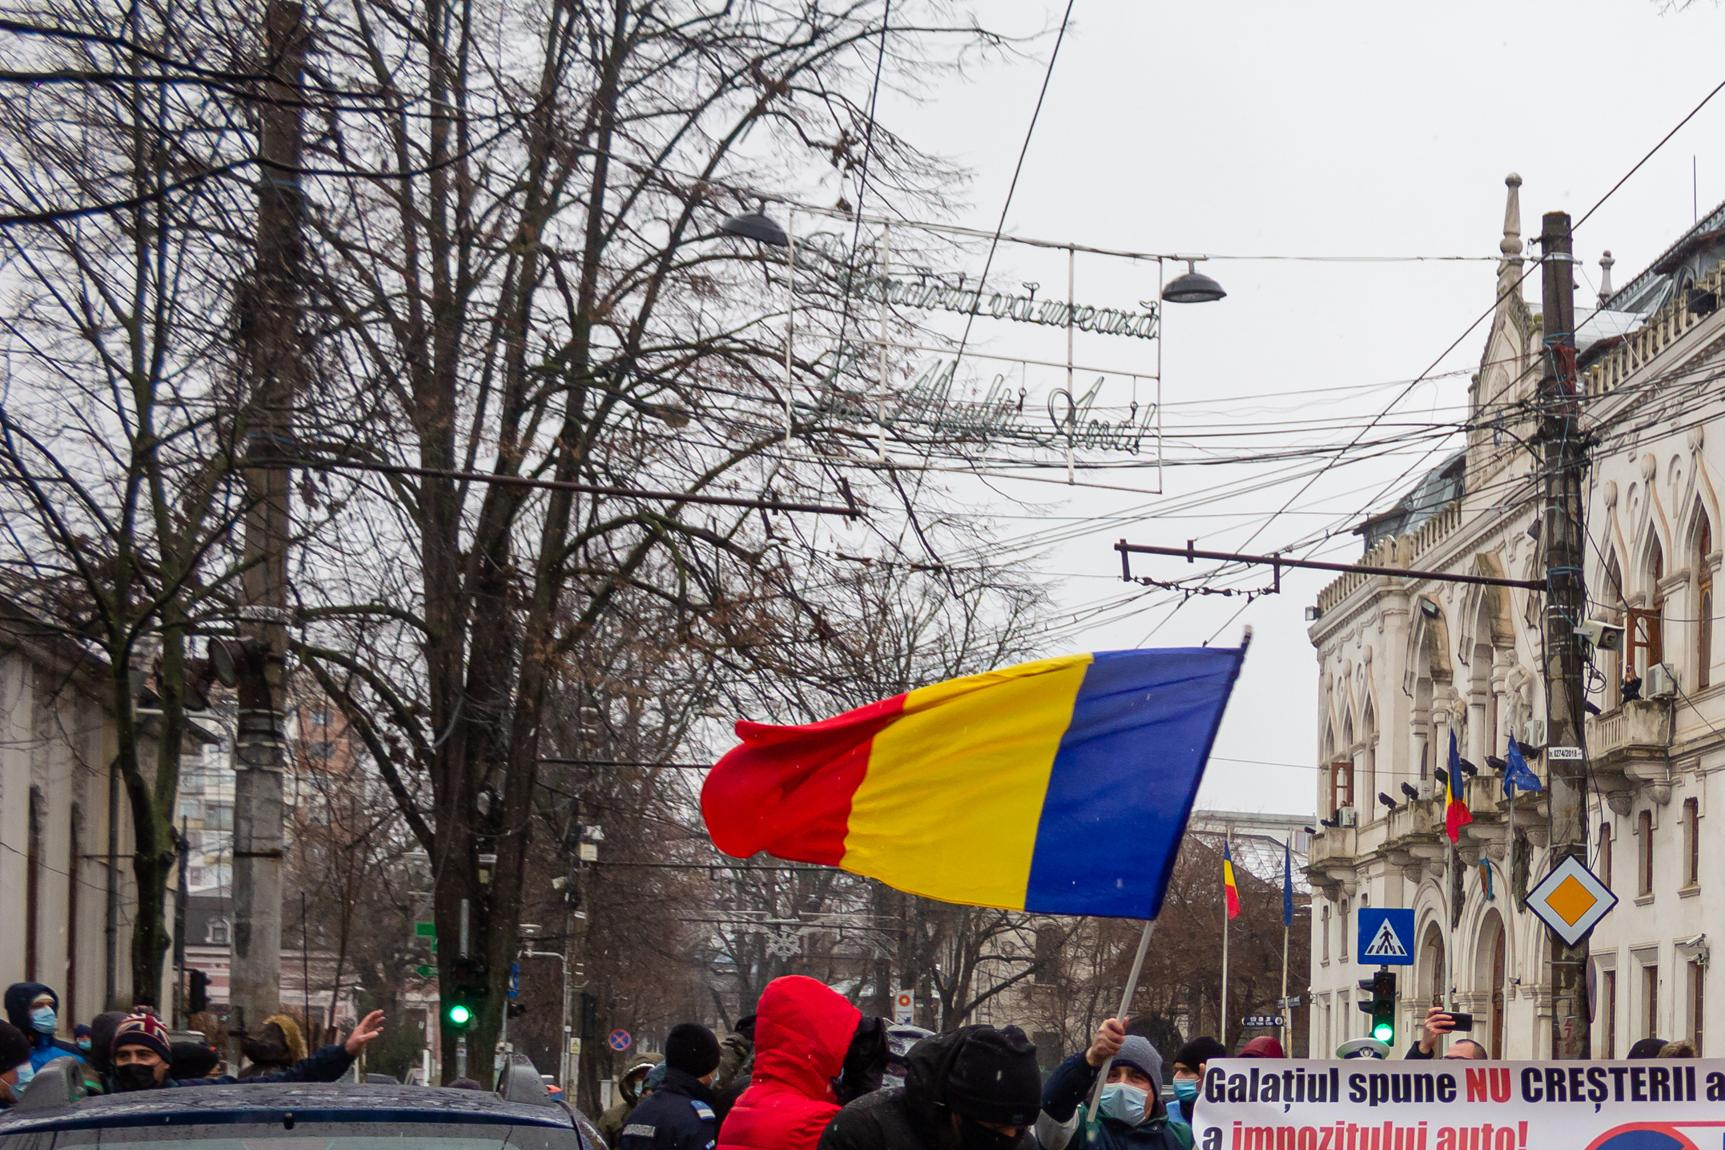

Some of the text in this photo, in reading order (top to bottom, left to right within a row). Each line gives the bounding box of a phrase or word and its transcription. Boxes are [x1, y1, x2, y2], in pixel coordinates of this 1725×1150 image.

[1205, 1067, 1339, 1113] Galațiul
[1349, 1071, 1456, 1106] spune
[1465, 1068, 1511, 1103] NU
[1520, 1066, 1697, 1113] CREȘTERII
